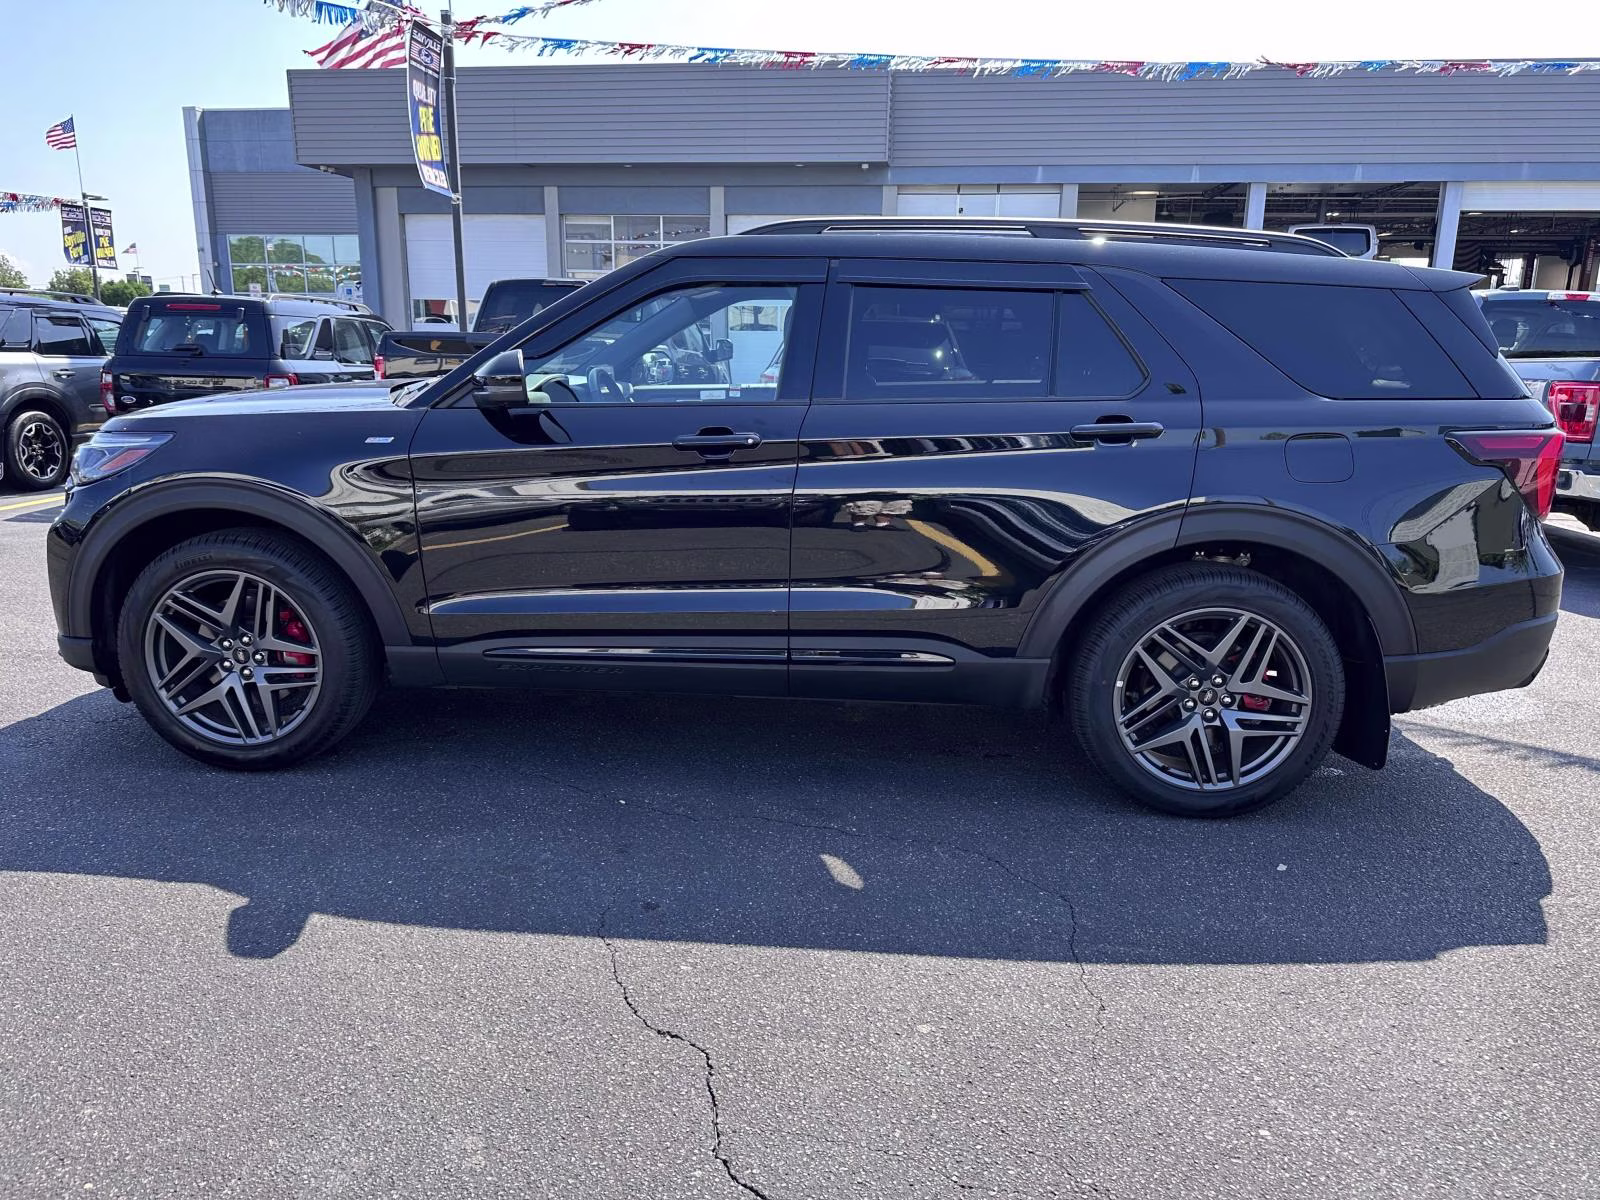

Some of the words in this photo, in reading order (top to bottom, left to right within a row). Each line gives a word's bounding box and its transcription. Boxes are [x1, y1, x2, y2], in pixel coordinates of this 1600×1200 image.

[412, 30, 441, 52] SAYVILLE
[413, 79, 437, 106] QUALITY
[419, 107, 435, 132] PRE
[497, 664, 625, 674] EXPLORER
